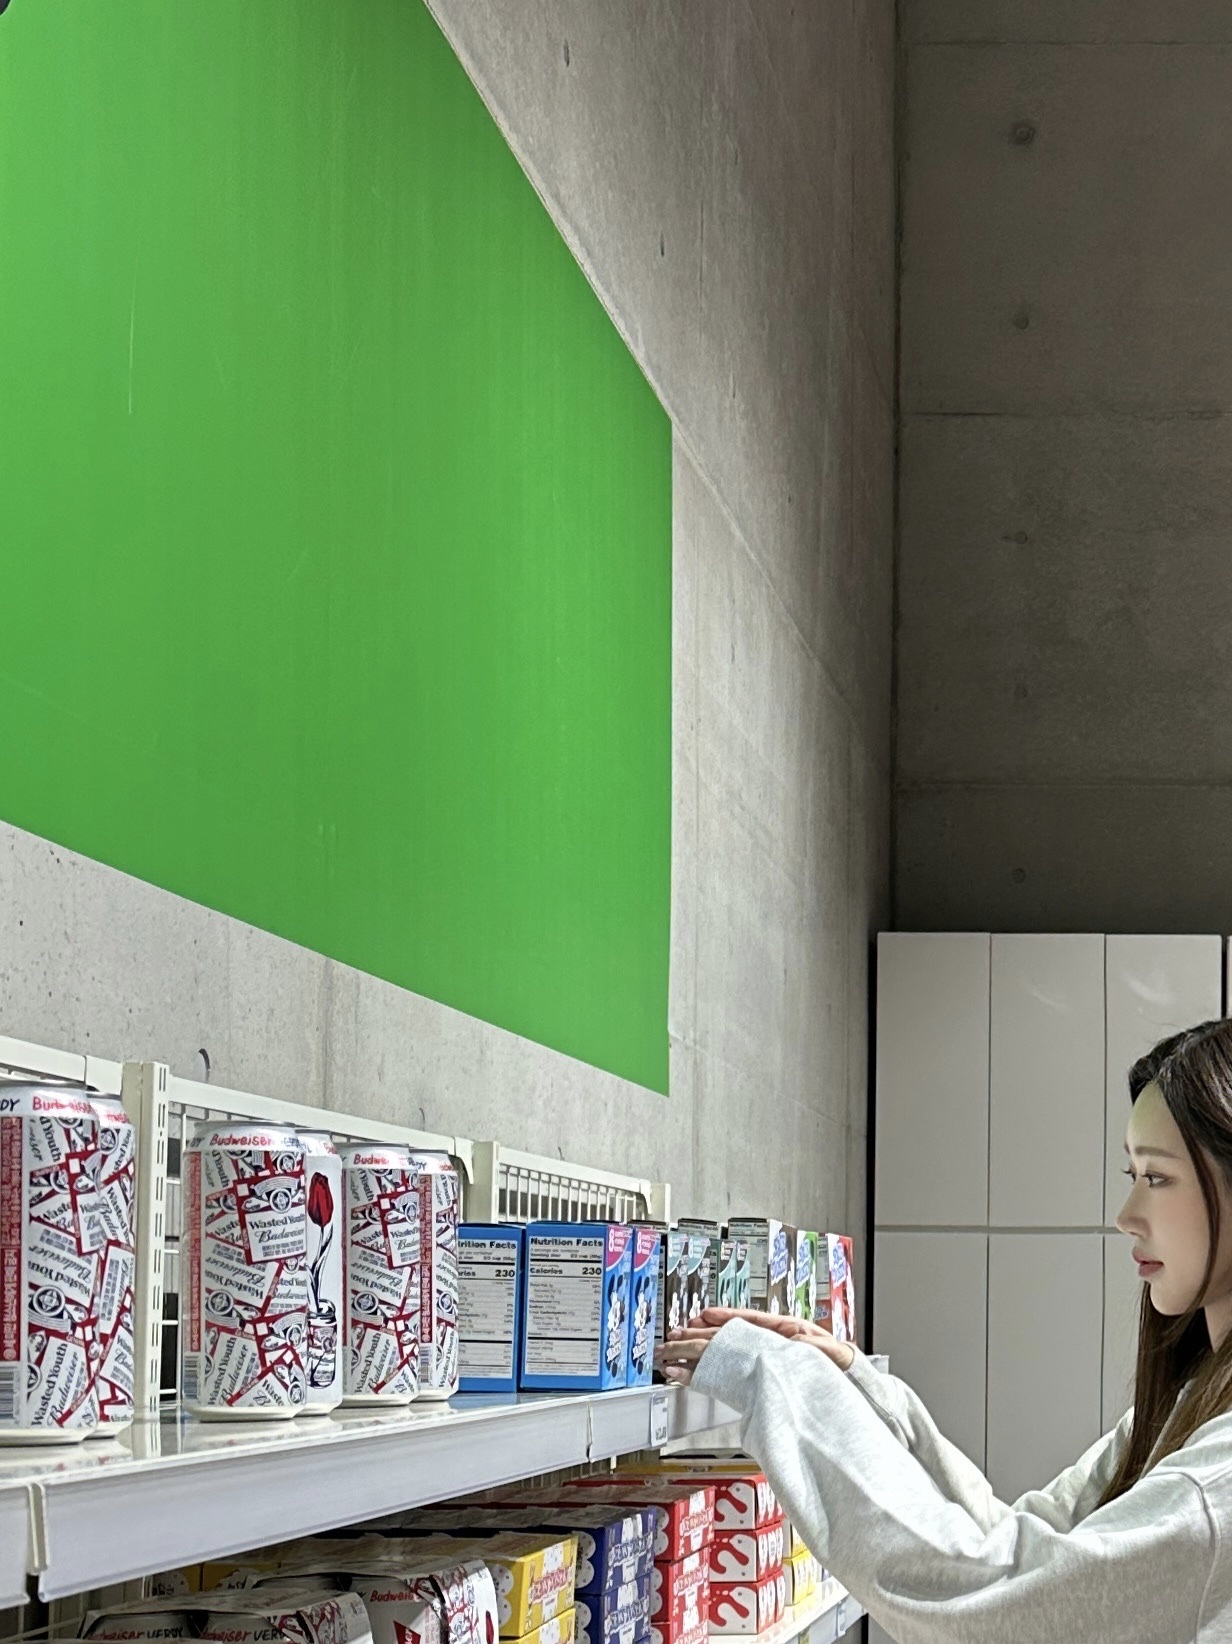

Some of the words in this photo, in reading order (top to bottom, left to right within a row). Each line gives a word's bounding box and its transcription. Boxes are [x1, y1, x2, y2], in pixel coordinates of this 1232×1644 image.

[248, 1215, 287, 1230] Wasted
[489, 1241, 516, 1250] Facts
[530, 1237, 573, 1247] Nutrition
[575, 1238, 603, 1248] Facts
[494, 1269, 516, 1278] 230
[530, 1266, 563, 1275] Calories
[581, 1267, 603, 1275] 230
[207, 1364, 228, 1405] Wasted
[221, 1336, 238, 1367] Youth
[32, 1378, 56, 1426] Wasted
[49, 1343, 69, 1381] Youth
